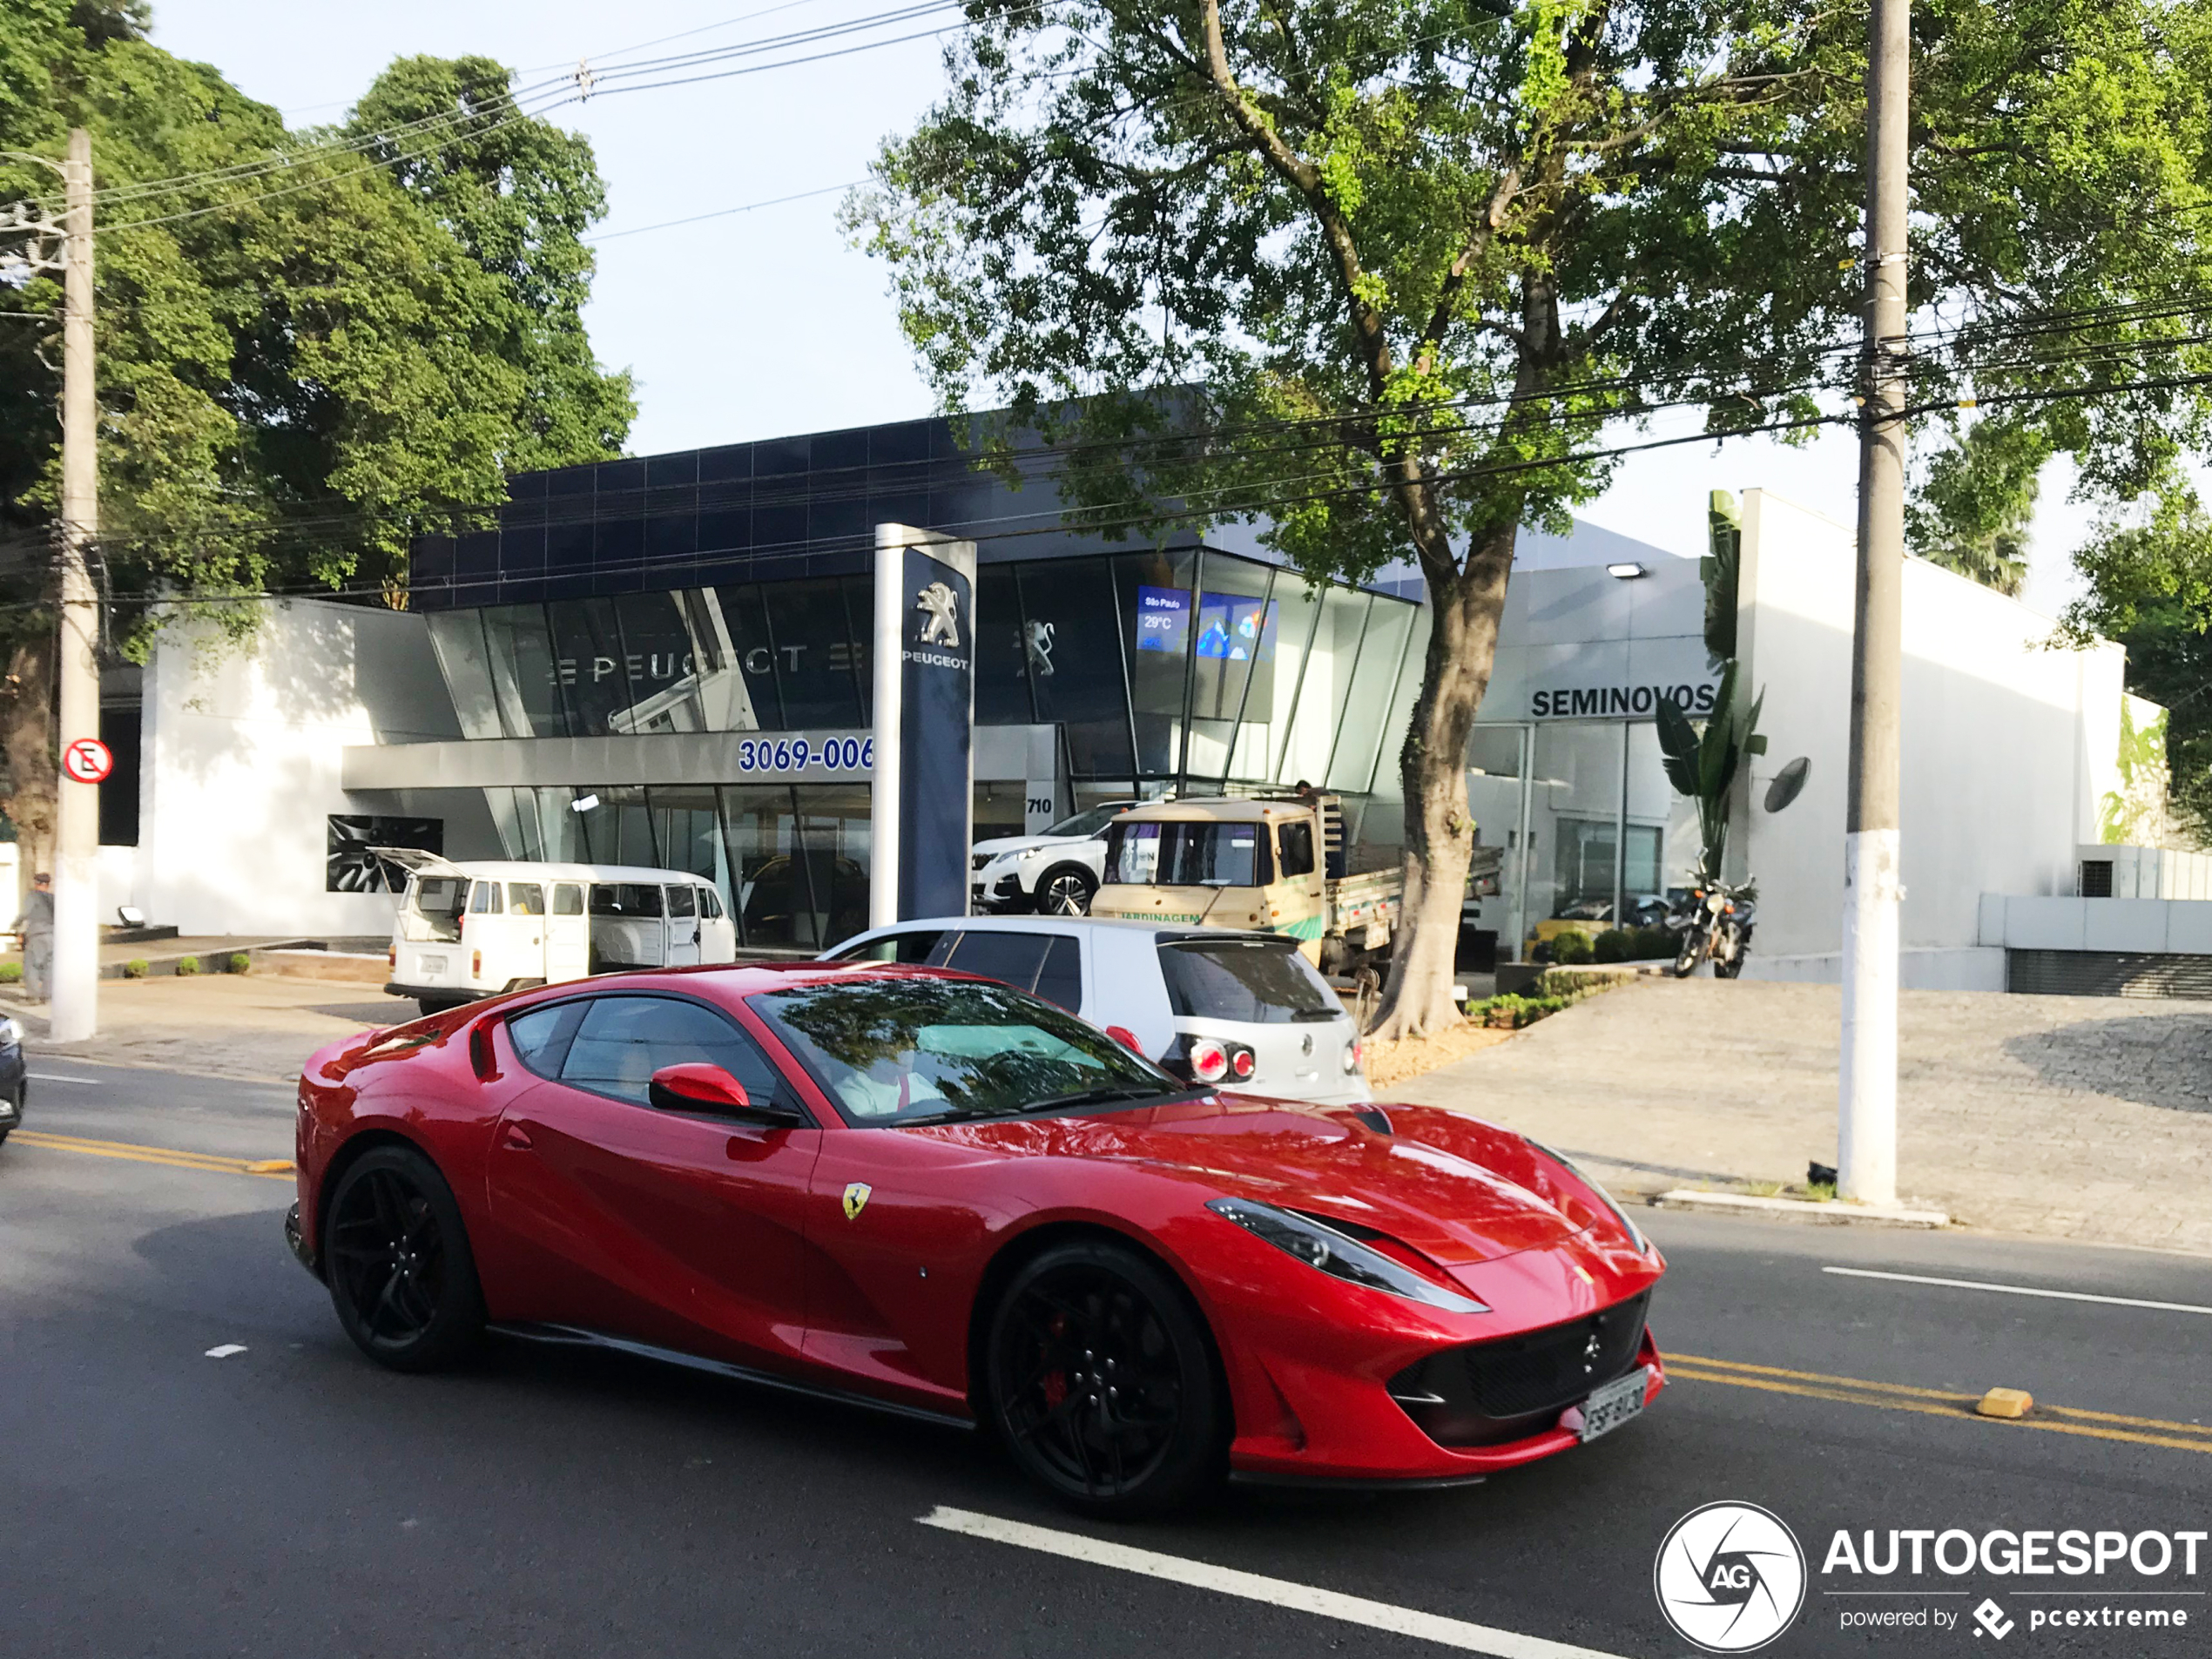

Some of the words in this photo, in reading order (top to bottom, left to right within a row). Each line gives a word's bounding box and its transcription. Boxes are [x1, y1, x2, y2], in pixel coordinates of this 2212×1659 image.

[1160, 598, 1180, 609] Paulo
[902, 650, 968, 670] PEUGEOT
[1028, 799, 1051, 813] 710
